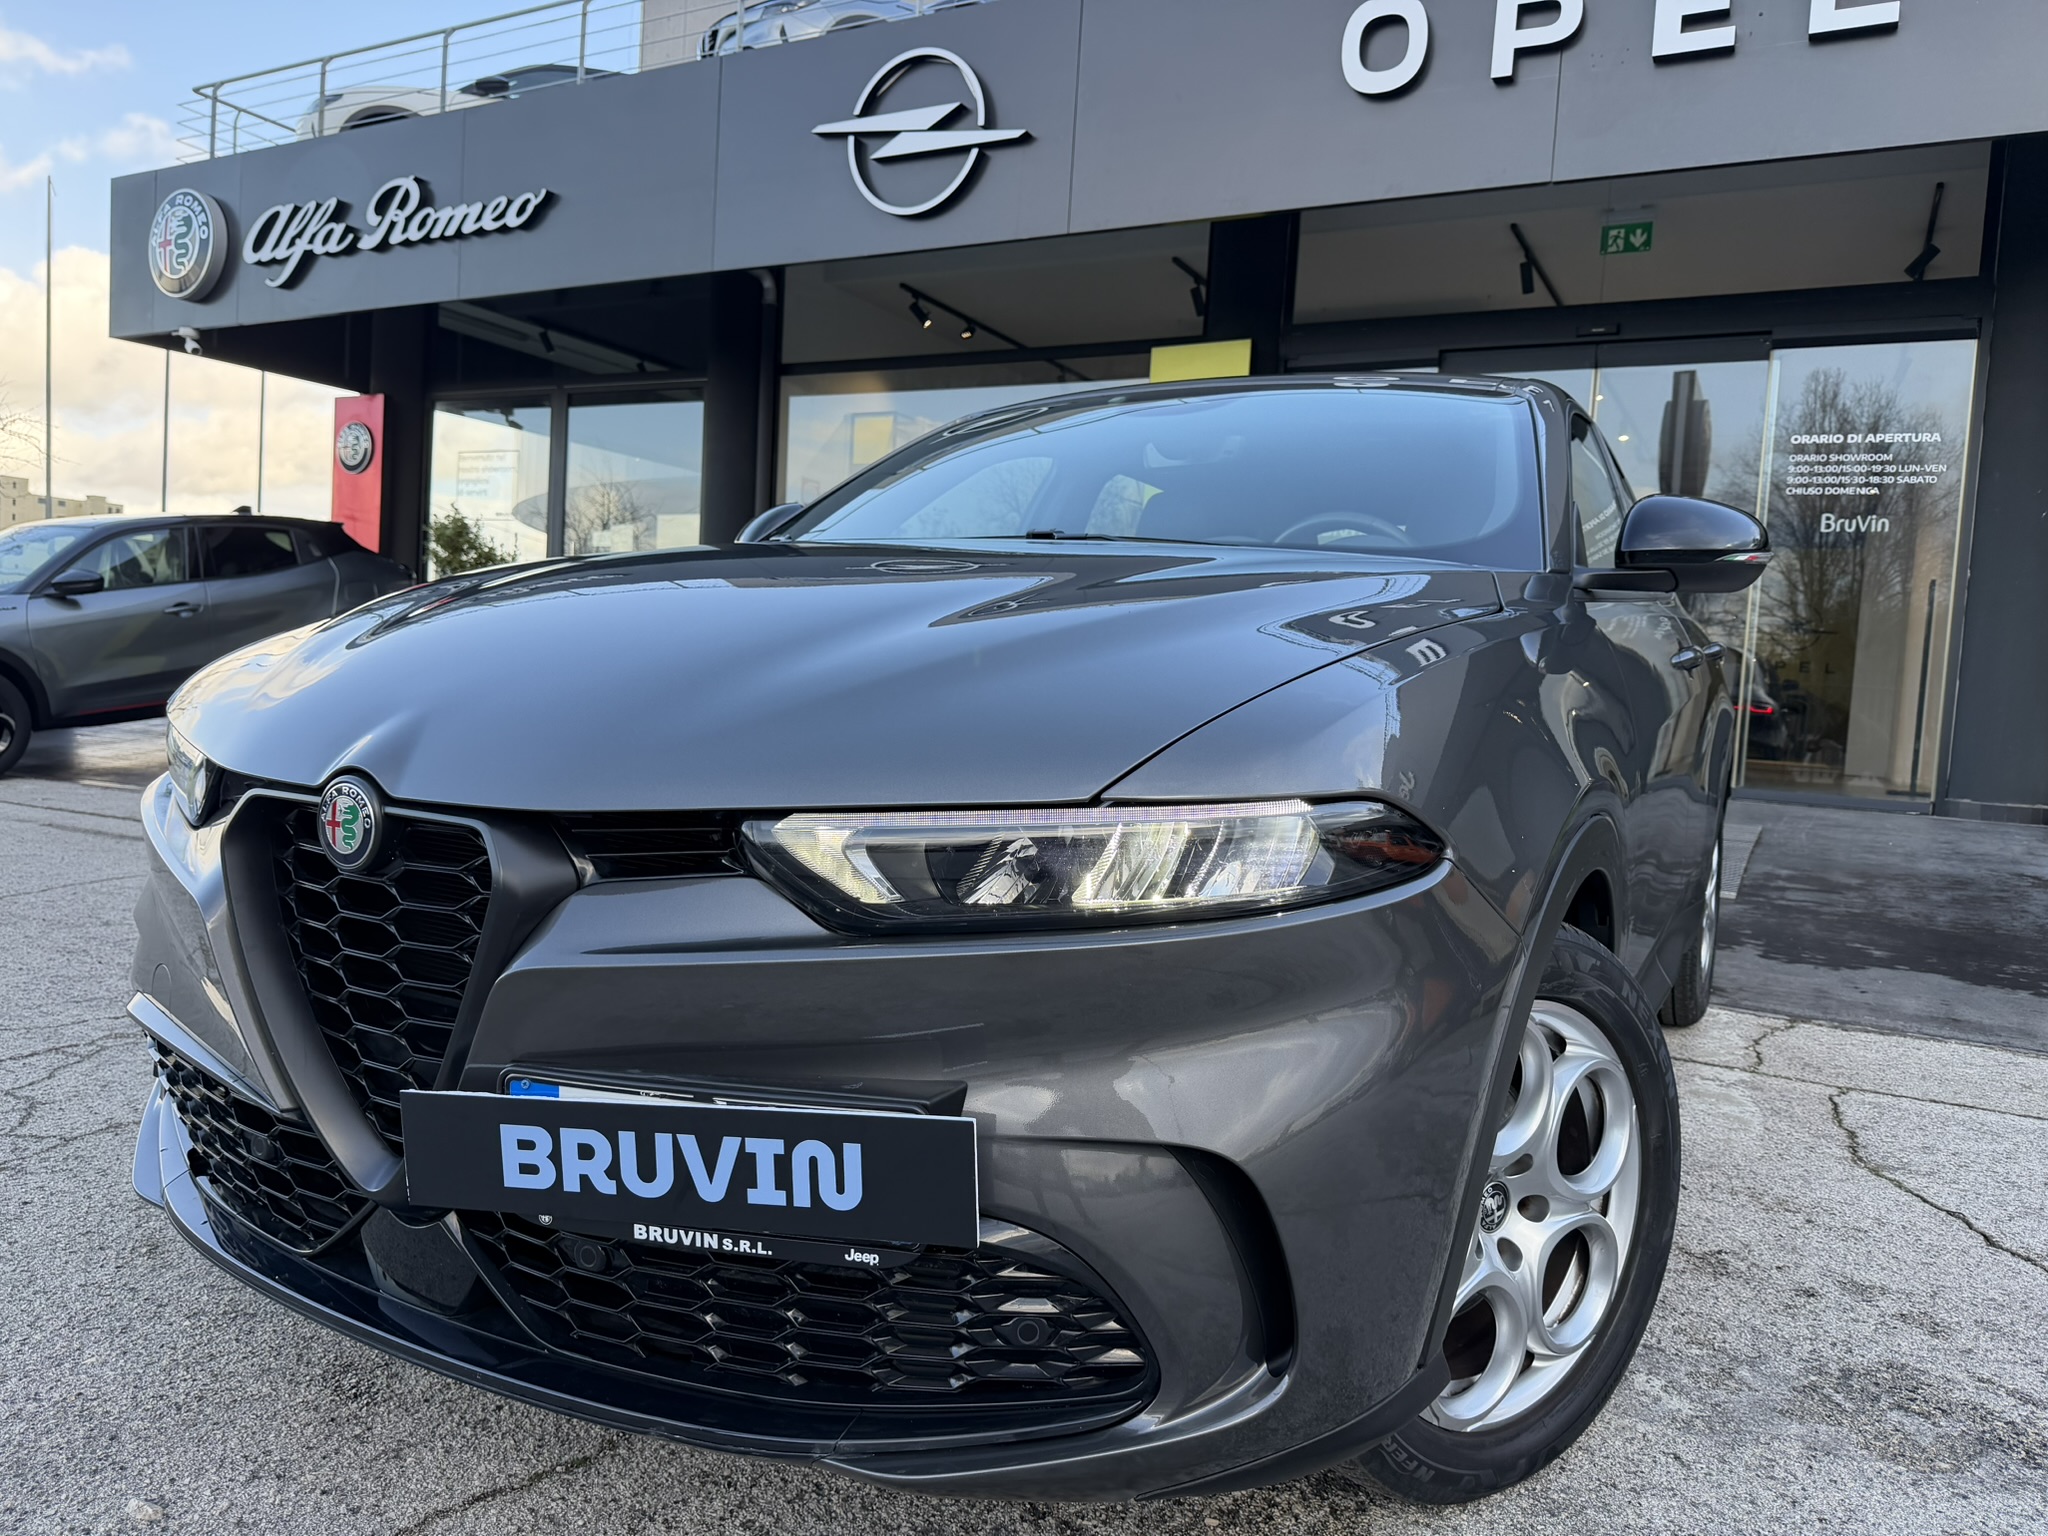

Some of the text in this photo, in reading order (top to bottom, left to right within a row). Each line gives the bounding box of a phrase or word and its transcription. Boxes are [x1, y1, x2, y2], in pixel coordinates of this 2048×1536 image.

[175, 194, 209, 240] ROMEO
[241, 174, 548, 288] Alfa Romeo
[1790, 432, 1941, 445] ORARIO DI APERTURA
[1789, 453, 1893, 463] ORARIO SHOWROOM
[1898, 463, 1947, 473] LUN-VEN
[1896, 475, 1938, 484] SABATO
[1785, 486, 1880, 496] CHIUSO DOMENICA
[1819, 512, 1890, 533] BruVin
[321, 786, 371, 829] ALFA ROMEO
[499, 1123, 864, 1212] BRUVIN
[633, 1223, 773, 1256] BRUVIN S.R.L.
[844, 1248, 880, 1267] Jeep
